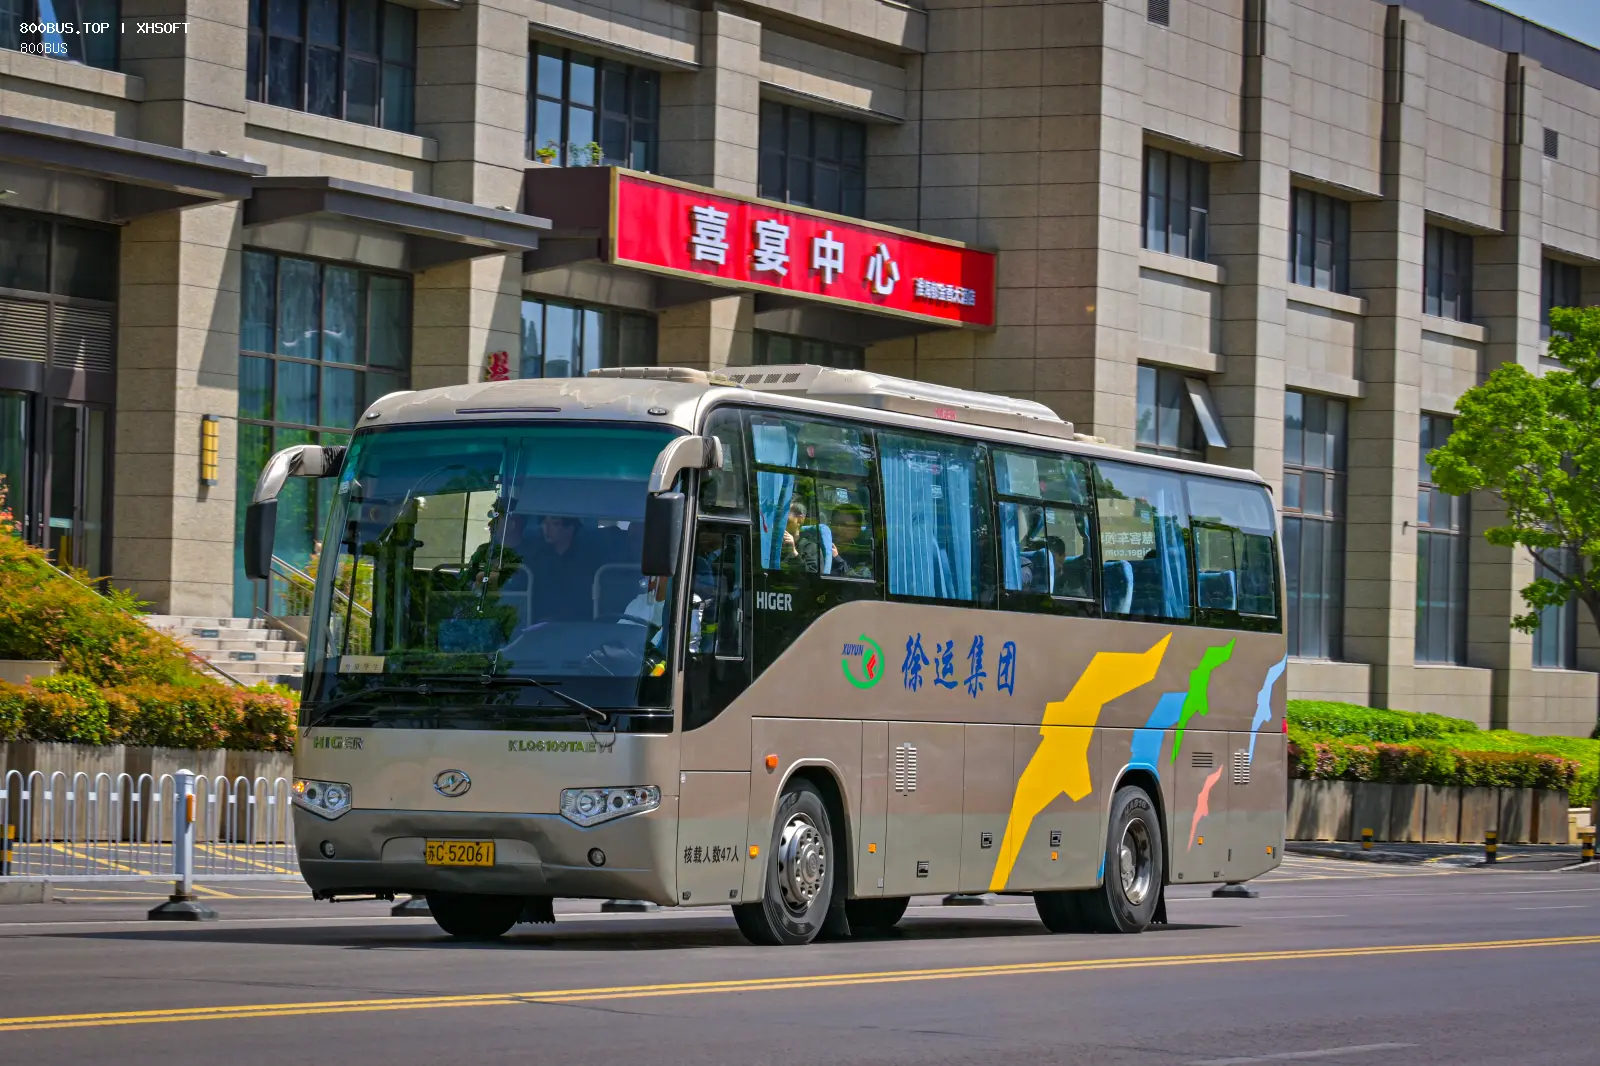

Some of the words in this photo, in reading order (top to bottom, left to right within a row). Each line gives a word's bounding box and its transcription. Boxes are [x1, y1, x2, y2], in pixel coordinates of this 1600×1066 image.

[692, 205, 900, 296] 喜宴中心
[756, 591, 793, 612] HIGER
[841, 643, 865, 657] XUYUN
[901, 632, 1017, 699] 徐运集团
[313, 736, 364, 750] HIGER
[683, 845, 740, 864] 核载人数47人
